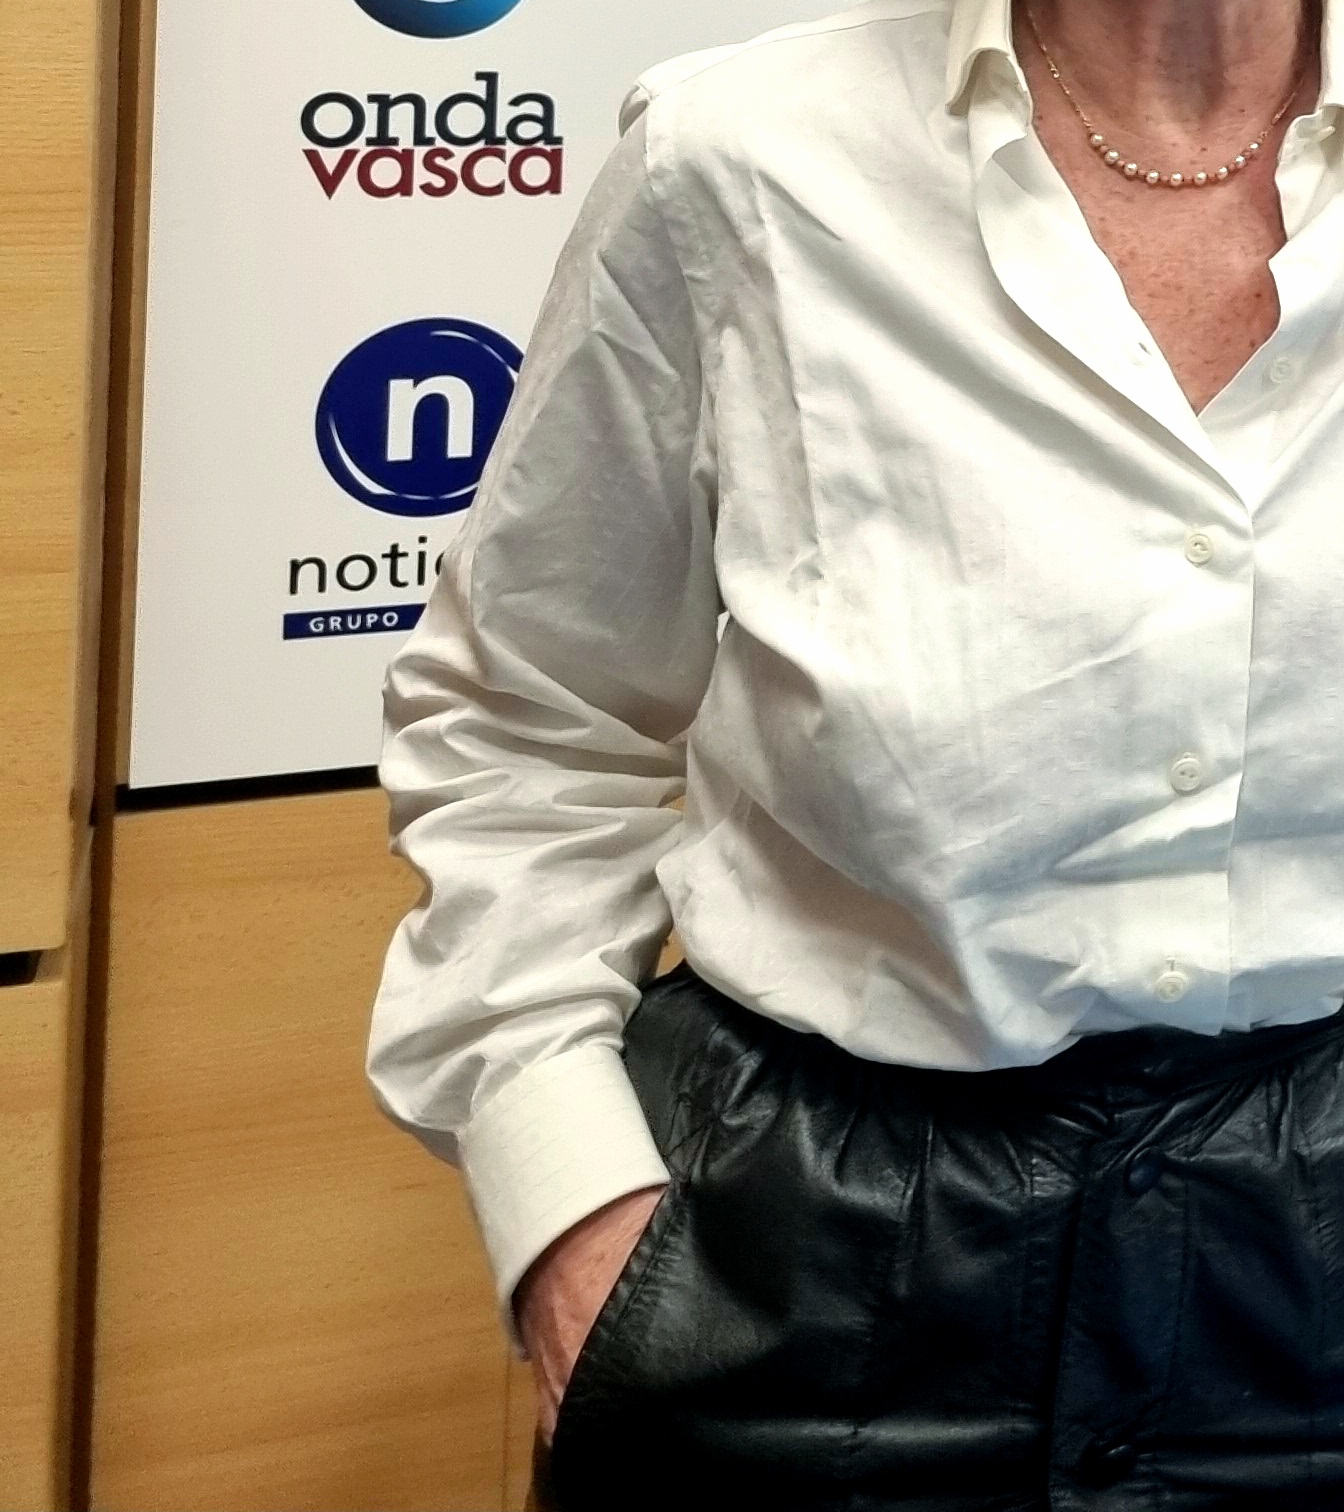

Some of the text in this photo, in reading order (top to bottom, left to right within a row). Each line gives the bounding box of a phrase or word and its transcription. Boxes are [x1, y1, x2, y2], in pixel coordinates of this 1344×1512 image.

[300, 72, 564, 147] onda
[302, 145, 563, 199] vasca
[385, 374, 474, 461] n
[289, 535, 444, 595] noti
[309, 612, 398, 633] GRUPO
